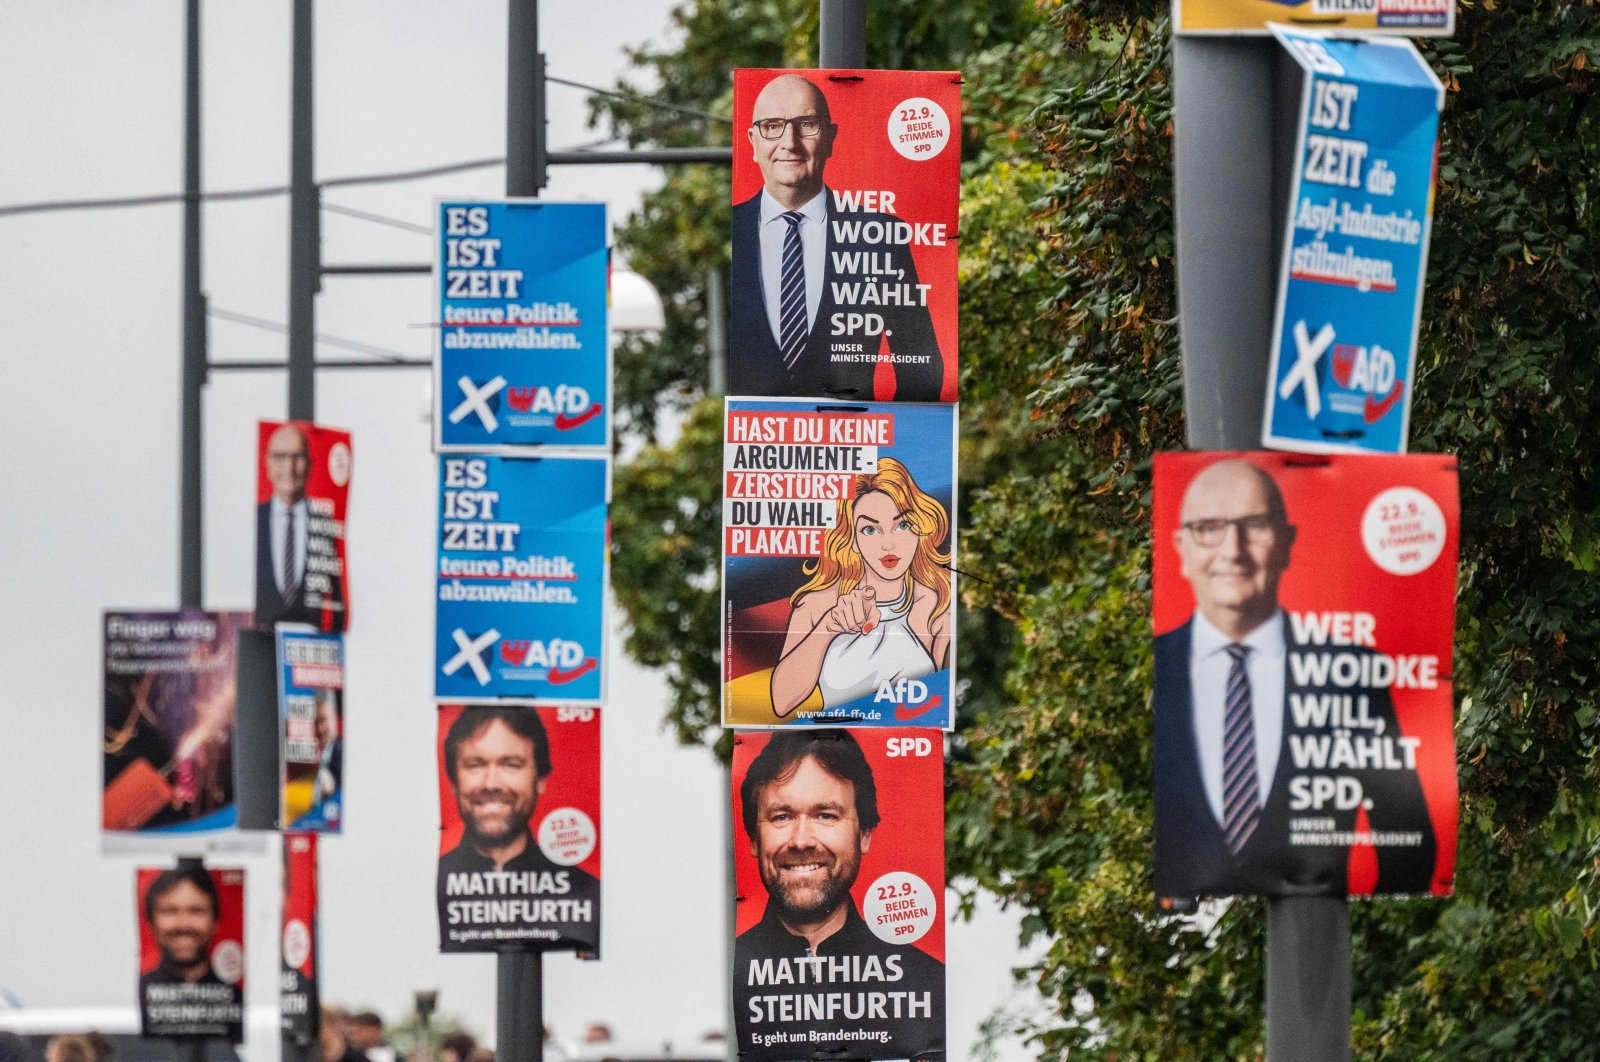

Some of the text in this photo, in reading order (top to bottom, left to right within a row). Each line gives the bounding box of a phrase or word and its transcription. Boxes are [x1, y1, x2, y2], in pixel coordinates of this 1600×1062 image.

[900, 106, 935, 121] 22.9.
[1311, 79, 1358, 132] IST
[899, 128, 944, 143] STIMMEN
[906, 121, 933, 133] BEIDE
[913, 143, 932, 154] SPD
[1305, 133, 1397, 196] ZEIT die
[832, 190, 897, 214] WER
[446, 207, 489, 236] ES
[832, 220, 947, 246] WOIDKE
[1296, 197, 1421, 245] Asyl-Industrie
[446, 239, 501, 267] IST
[831, 252, 905, 280] WILL,
[1291, 241, 1397, 293] stillzulegen.
[446, 270, 523, 298] ZEIT
[831, 277, 932, 307] WÄHLT
[444, 302, 578, 324] teure Politik
[830, 313, 893, 337] SPD.
[444, 327, 582, 349] abzuwählen.
[830, 343, 863, 352] UNSER
[830, 352, 931, 364] MINISTERPRÄSIDENT
[1352, 344, 1397, 394] AfD
[531, 384, 590, 413] AfD
[732, 416, 890, 444] HAST DU KEINE
[444, 459, 488, 489] ES
[731, 472, 852, 499] ZERSTÖRST
[443, 491, 499, 520] IST
[731, 501, 833, 527] DU WAHL-
[443, 523, 521, 551] ZEIT
[730, 530, 821, 555] PLAKATE
[440, 555, 575, 577] teure Politik
[439, 580, 578, 603] abzuwählen.
[1288, 610, 1377, 647] WER
[524, 638, 584, 667] AfD
[1288, 652, 1439, 690] WOIDKE
[873, 677, 928, 703] AfD
[796, 709, 882, 720] wwwafd-ffo.de
[1288, 693, 1386, 736] WILL,
[886, 737, 932, 757] SPD
[1287, 729, 1422, 771] WÄHLT
[1288, 776, 1375, 811] SPD.
[1288, 817, 1336, 831] UNSER
[446, 871, 571, 896] MATTHIAS
[876, 882, 918, 901] 22.9.
[447, 899, 592, 924] STEINFURTH
[876, 907, 929, 926] STIMMEN
[885, 899, 917, 913] BEIDE
[894, 924, 915, 936] SPD
[747, 954, 904, 986] MATTHIAS
[748, 991, 932, 1023] STEINFURTH
[751, 1028, 893, 1047] Es geht um Brandenburg.
